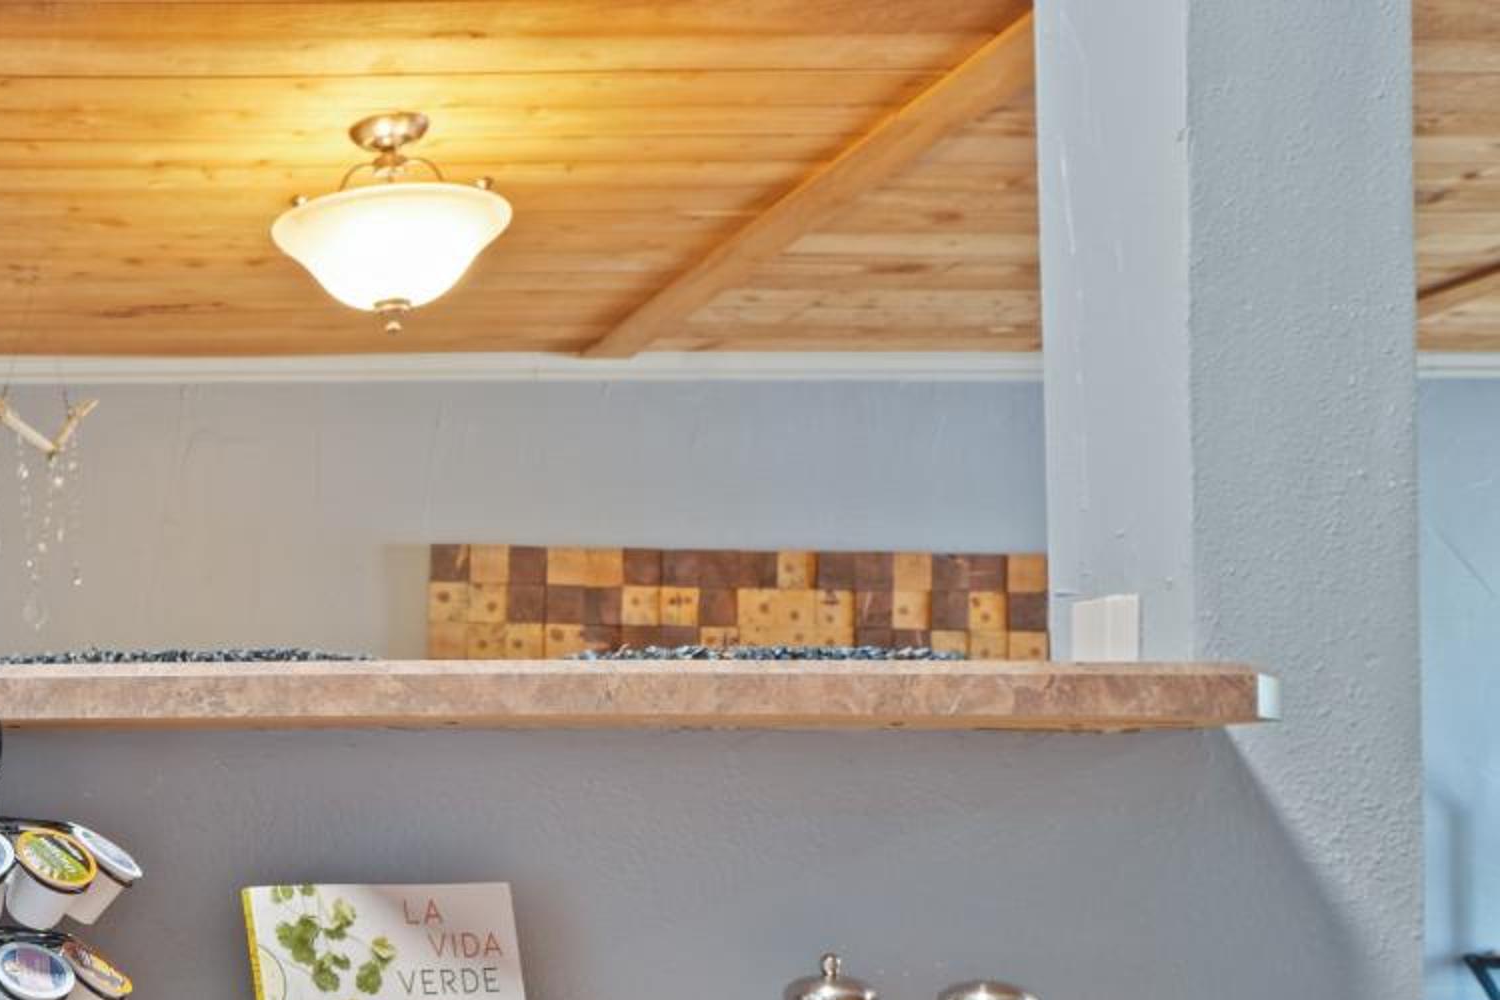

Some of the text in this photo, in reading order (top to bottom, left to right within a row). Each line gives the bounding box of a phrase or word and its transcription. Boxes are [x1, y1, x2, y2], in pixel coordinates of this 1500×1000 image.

[402, 899, 444, 925] LA
[427, 931, 504, 959] VIDA
[397, 966, 501, 995] VERDE
